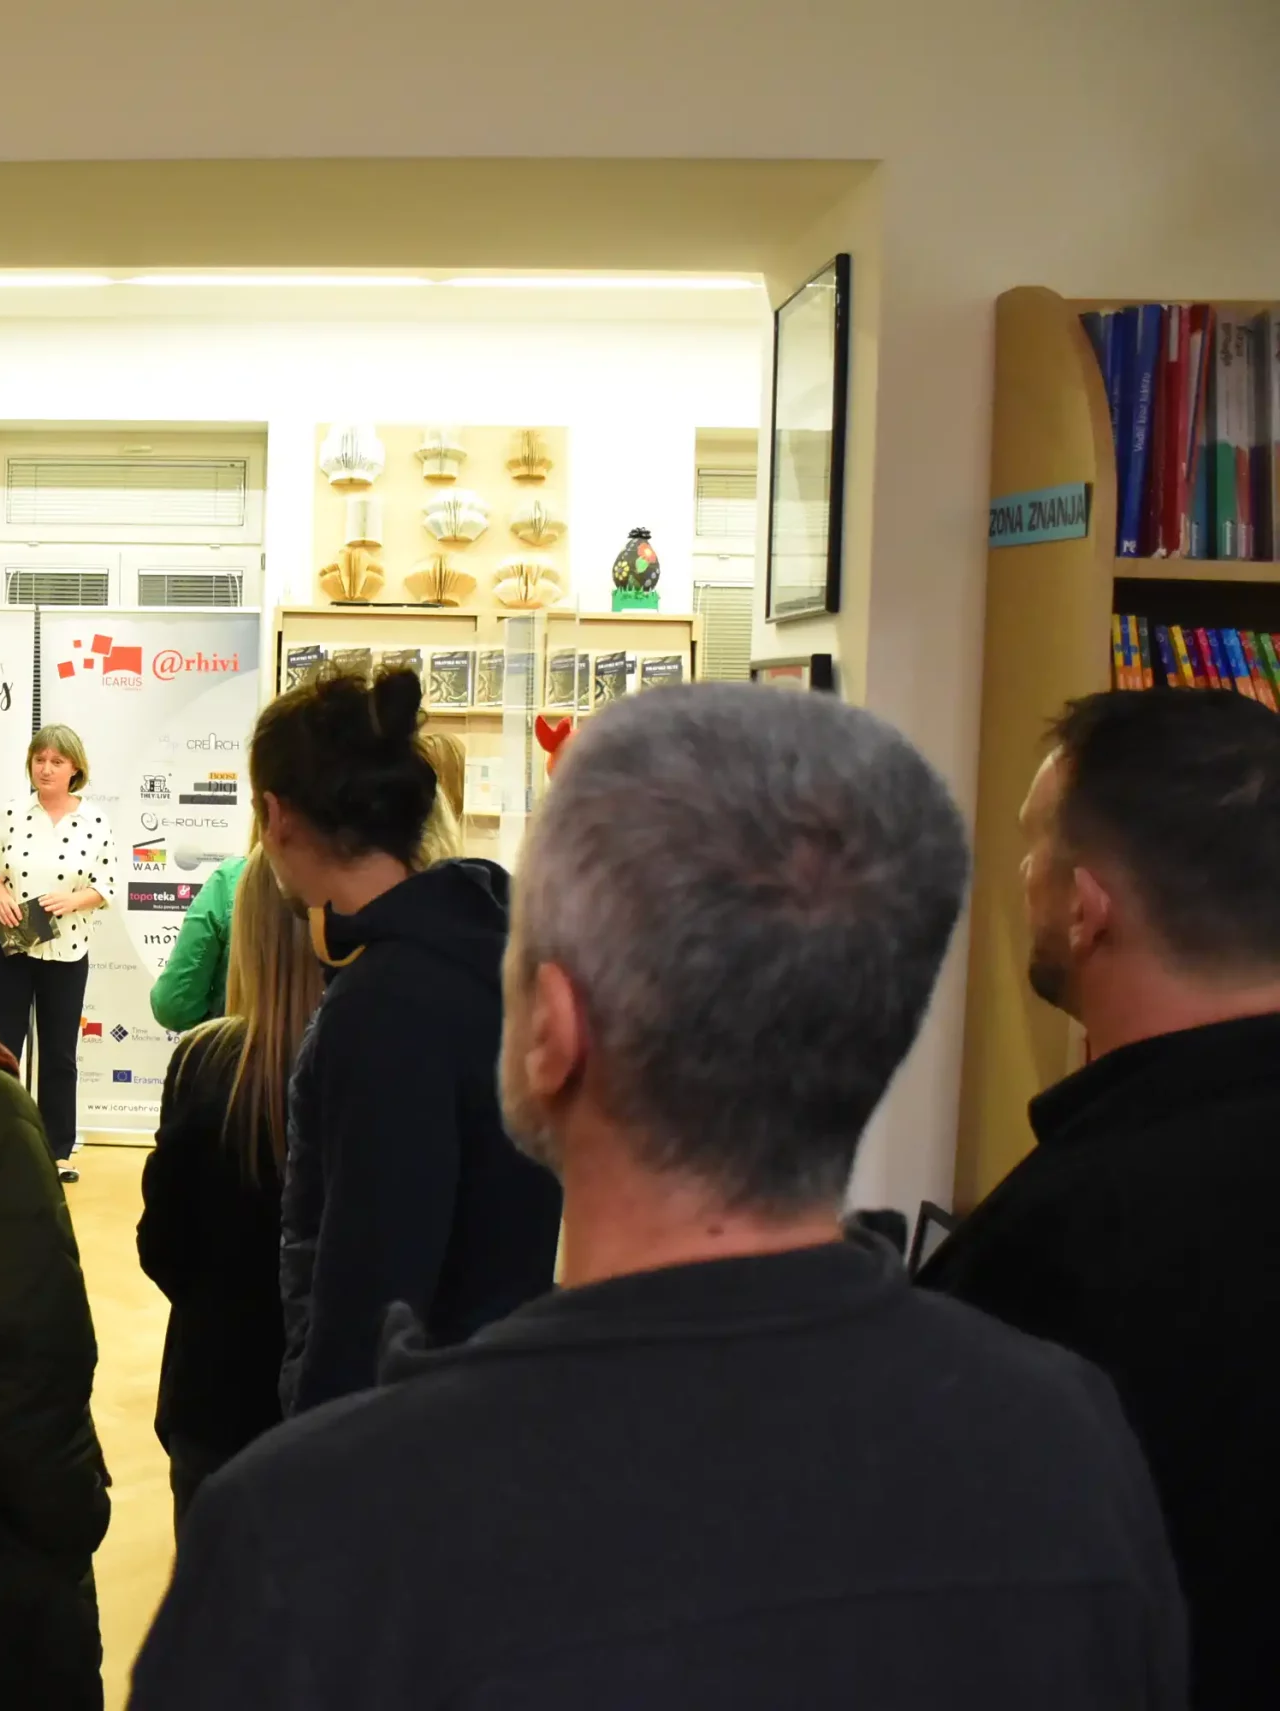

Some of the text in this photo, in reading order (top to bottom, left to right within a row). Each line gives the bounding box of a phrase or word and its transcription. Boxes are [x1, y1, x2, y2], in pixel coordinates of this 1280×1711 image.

[989, 492, 1085, 537] ZONA ZNANJA
[152, 649, 240, 681] @rhivi
[102, 677, 143, 687] ICARUS
[161, 818, 229, 828] E-ROUTES
[133, 863, 167, 871] WAAT
[129, 892, 176, 903] topoteka
[88, 962, 137, 971] ortal Europe
[133, 1076, 165, 1085] Erasmu
[87, 1103, 161, 1113] www.icarushrva
